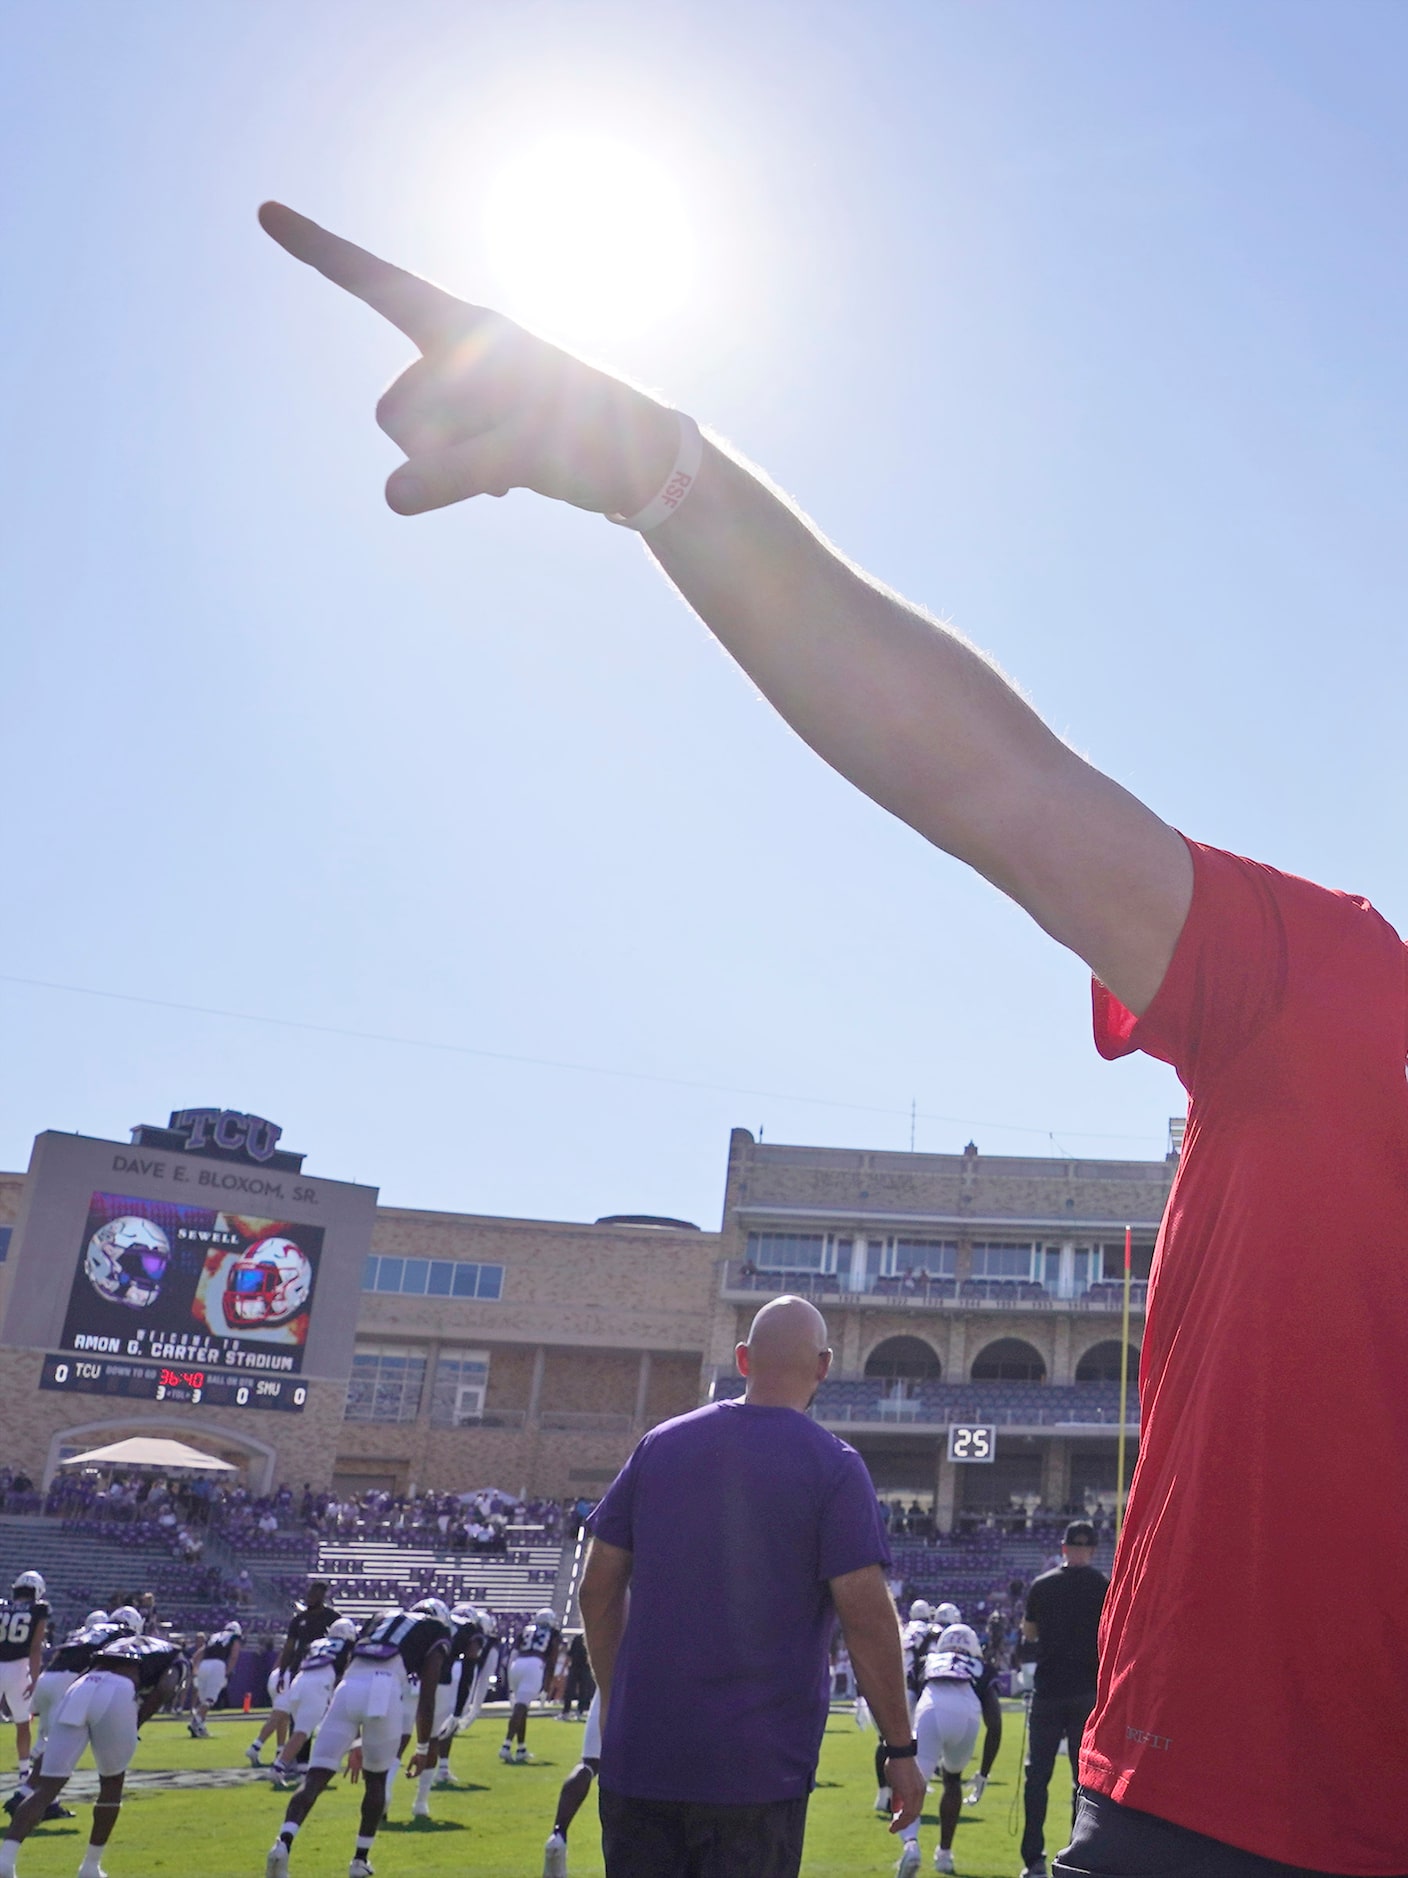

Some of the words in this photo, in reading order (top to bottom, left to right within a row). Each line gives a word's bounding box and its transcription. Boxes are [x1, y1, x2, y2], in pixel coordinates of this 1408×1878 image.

[661, 471, 692, 509] RSF
[179, 1108, 281, 1162] TCU
[112, 1156, 165, 1179] DAVE
[173, 1165, 190, 1183] E.
[292, 1187, 319, 1204] SR.
[177, 1228, 239, 1245] SEWELL
[74, 1334, 121, 1353] AMON
[127, 1341, 142, 1356] G.
[151, 1342, 220, 1363] CARTER
[225, 1352, 293, 1371] STADIUM
[54, 1364, 68, 1383] 0
[75, 1362, 101, 1378] TCU
[159, 1368, 204, 1388] 36:40
[156, 1386, 166, 1400] 3
[192, 1389, 202, 1404] 3
[236, 1387, 248, 1405] 0
[256, 1381, 281, 1396] SMU
[293, 1388, 306, 1405] 0
[954, 1428, 989, 1458] 25
